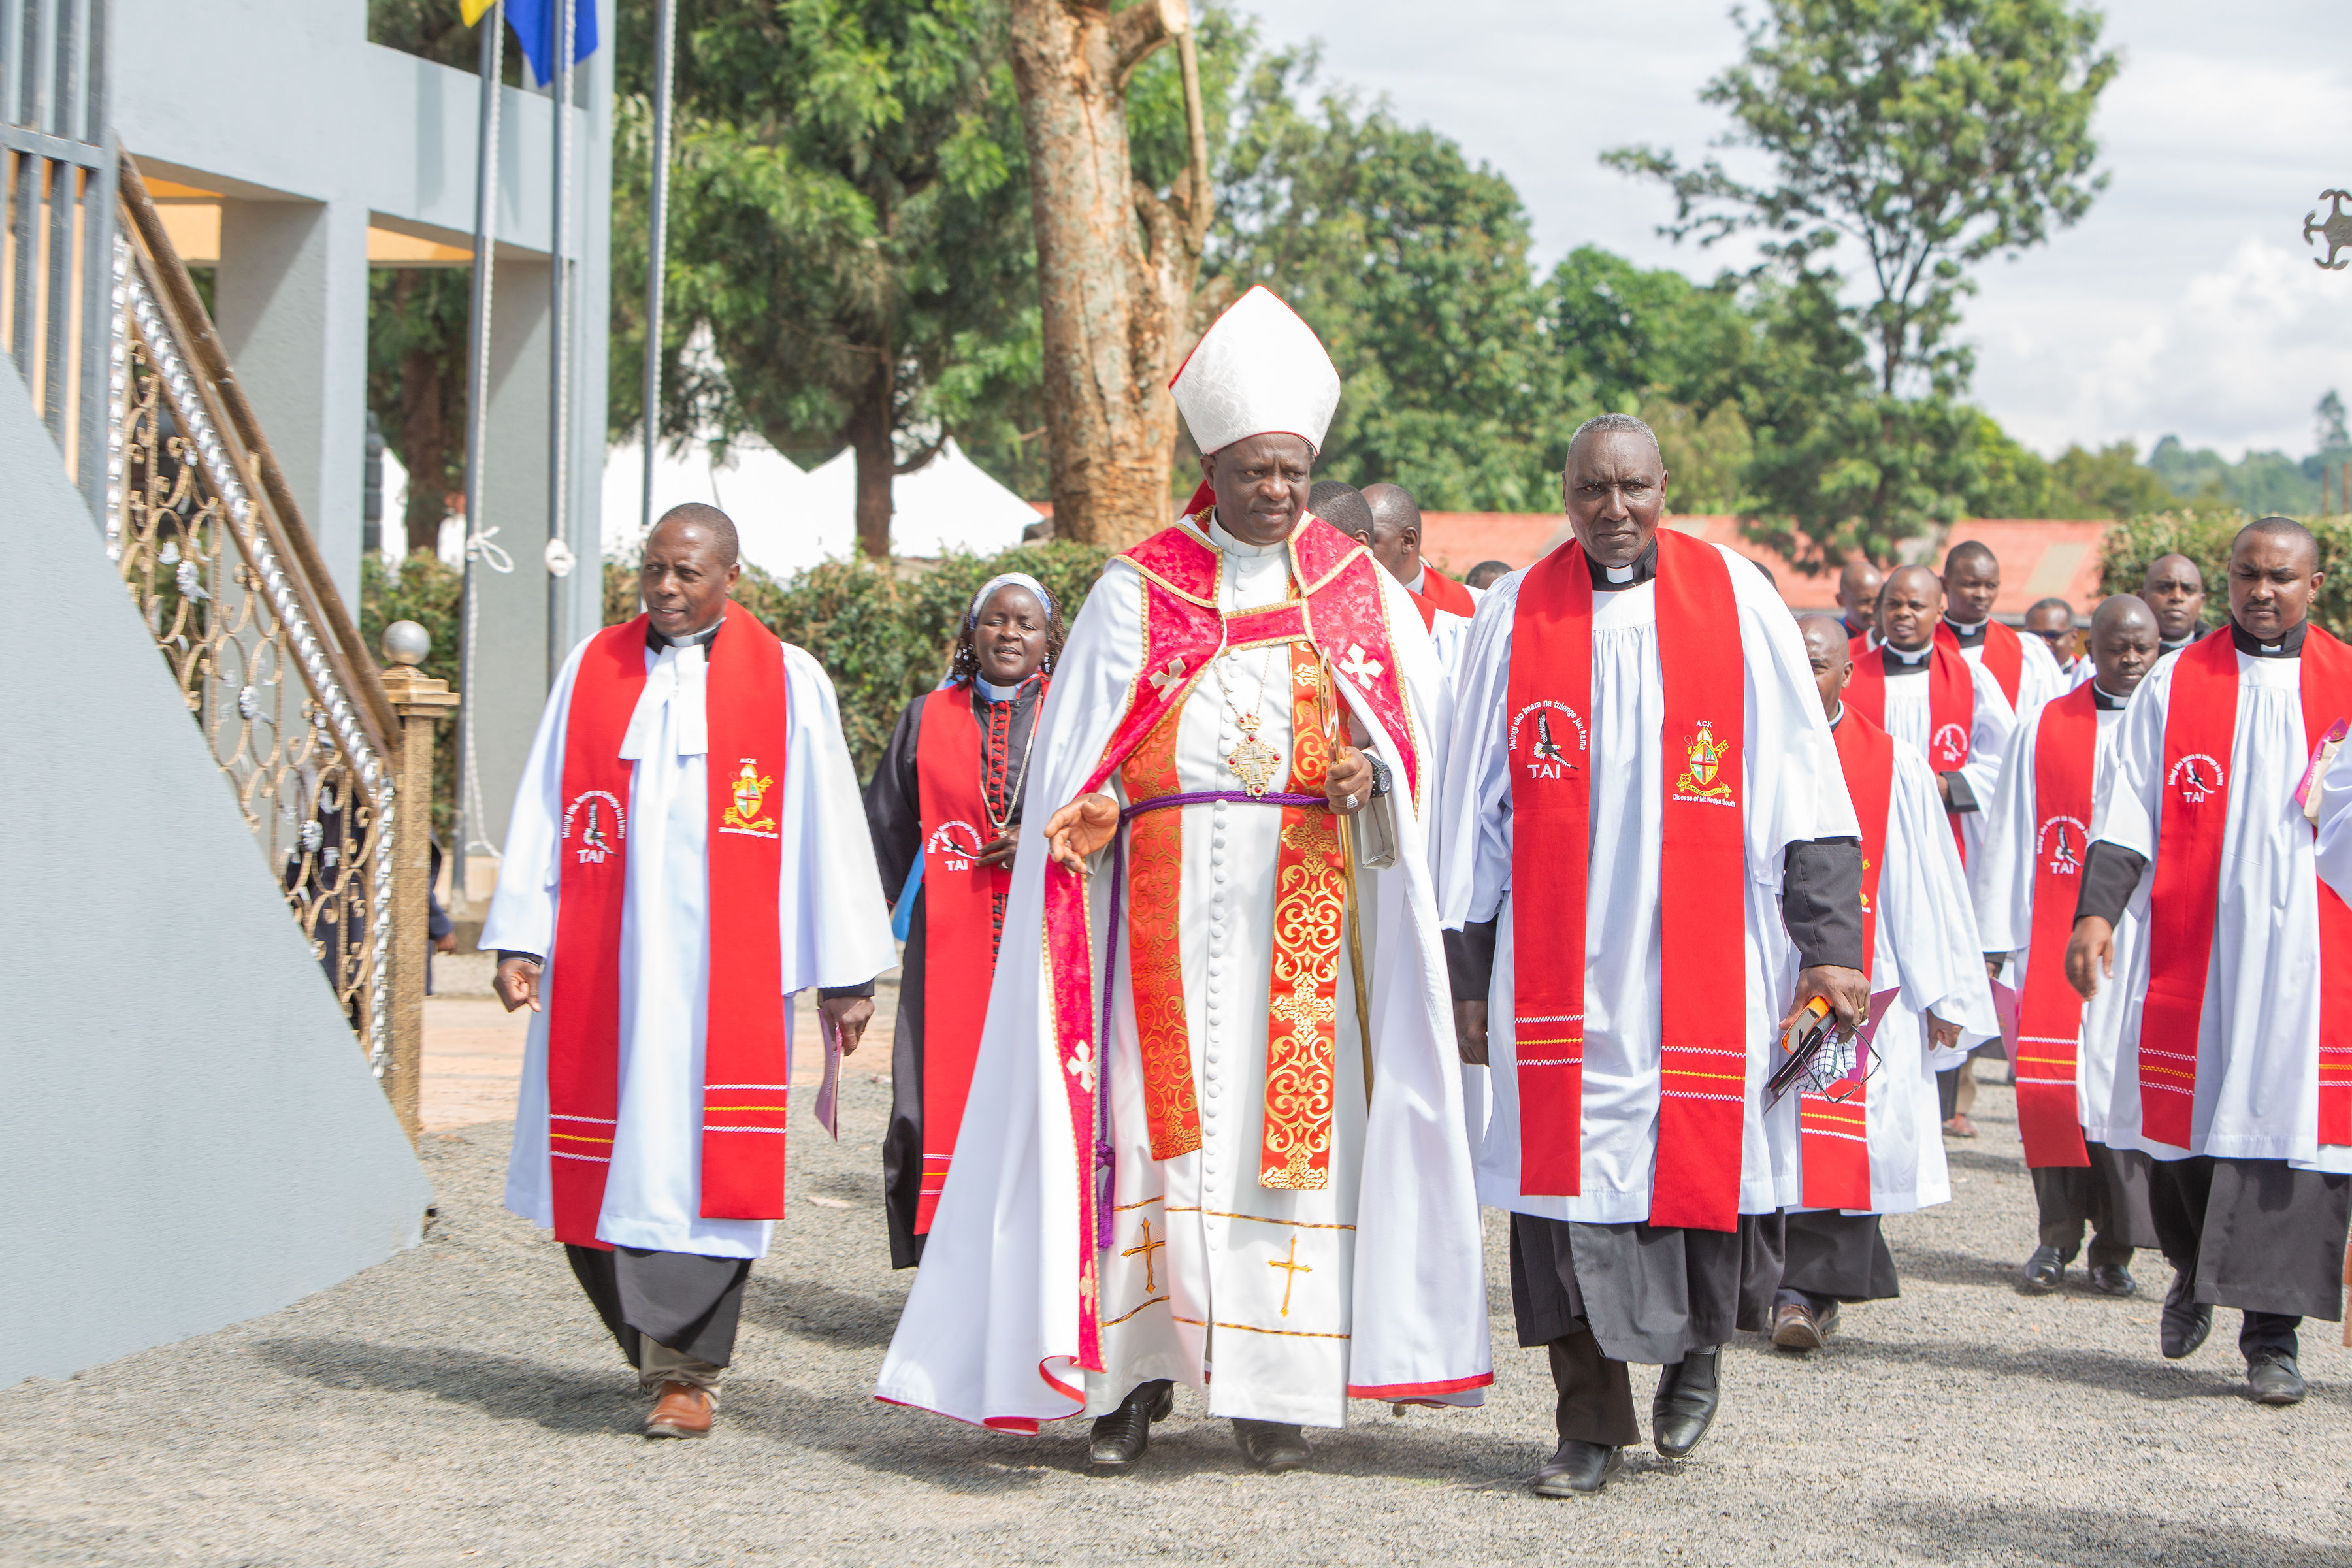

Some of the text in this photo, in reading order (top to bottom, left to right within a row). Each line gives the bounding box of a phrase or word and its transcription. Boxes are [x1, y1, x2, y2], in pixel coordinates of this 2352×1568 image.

[1514, 713, 1524, 726] uko
[1554, 700, 1576, 719] tulenge
[1572, 717, 1584, 730] juu
[1578, 730, 1588, 751] kama
[1527, 764, 1560, 779] TAI
[1707, 796, 1722, 805] Kenya
[1722, 798, 1735, 807] South
[2183, 791, 2204, 803] TAI
[576, 849, 605, 864] TAI
[944, 859, 968, 871] TAI
[2050, 862, 2074, 874] TAI
